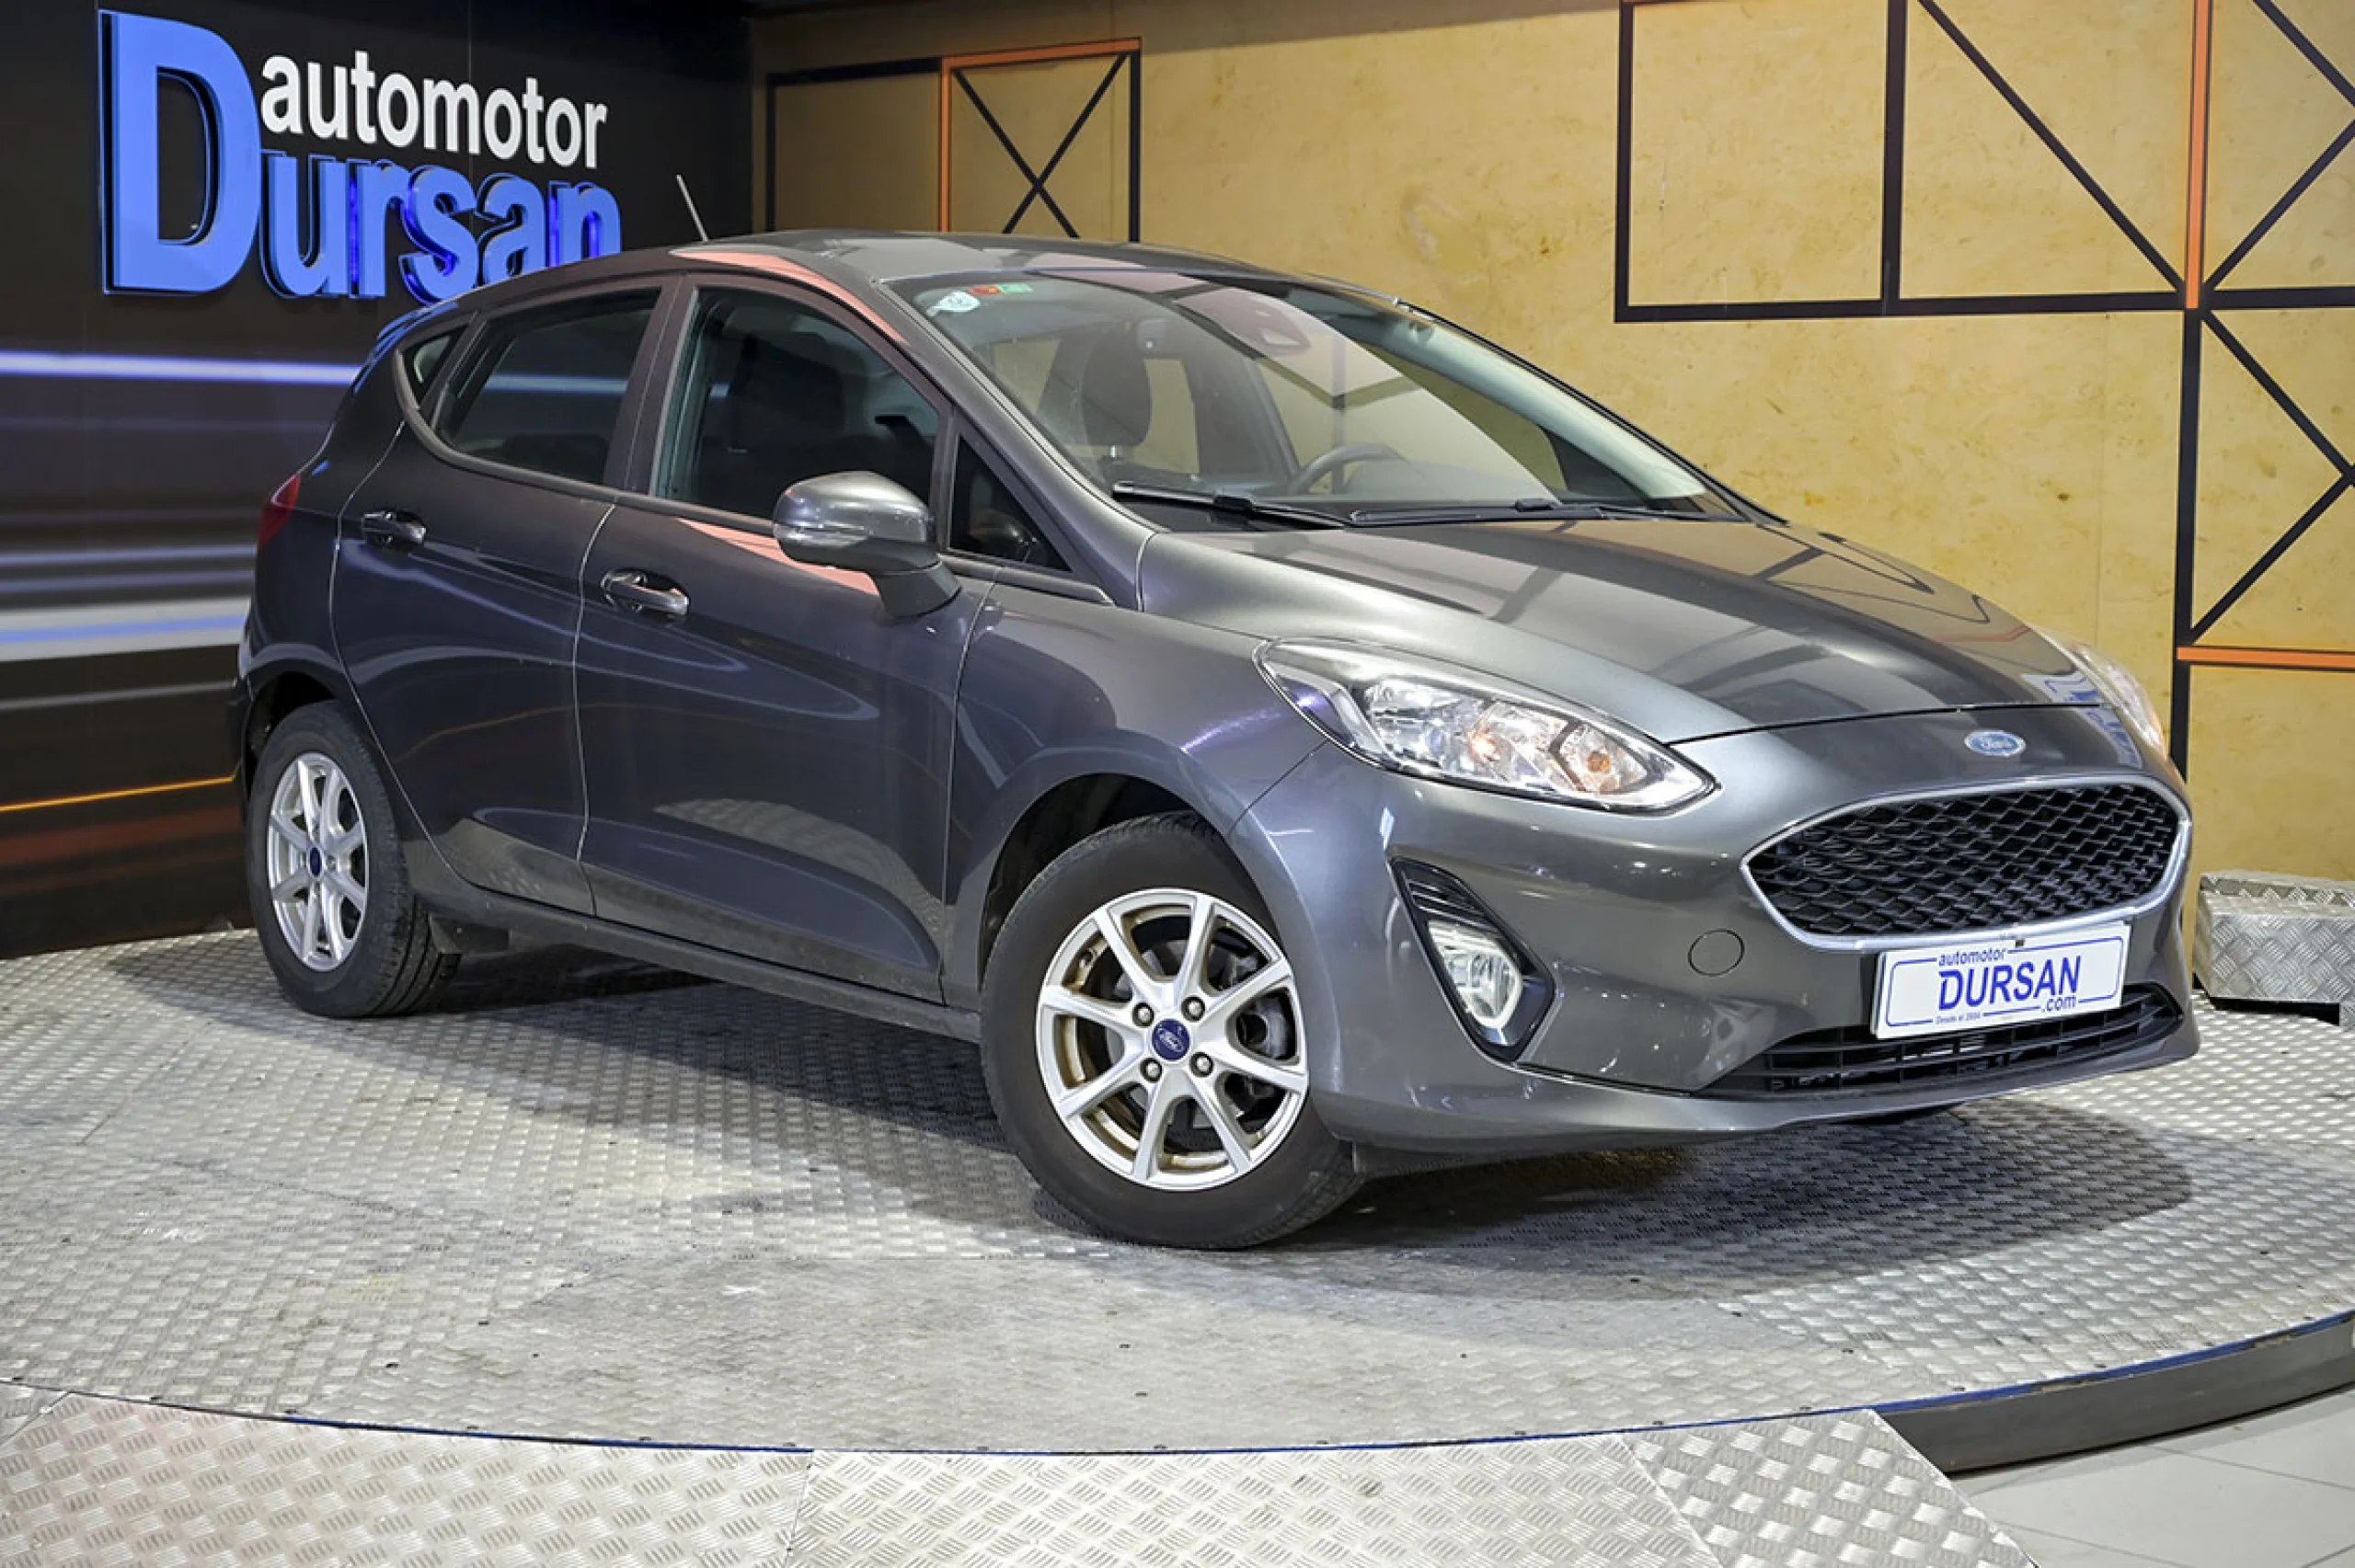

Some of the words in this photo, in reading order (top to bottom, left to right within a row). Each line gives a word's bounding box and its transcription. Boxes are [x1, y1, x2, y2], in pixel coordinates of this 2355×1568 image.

[261, 51, 607, 168] automotor
[98, 9, 622, 305] Dursan
[1938, 947, 2006, 967] automotor
[1938, 956, 2082, 1011] DURSAN
[2041, 995, 2077, 1013] .com
